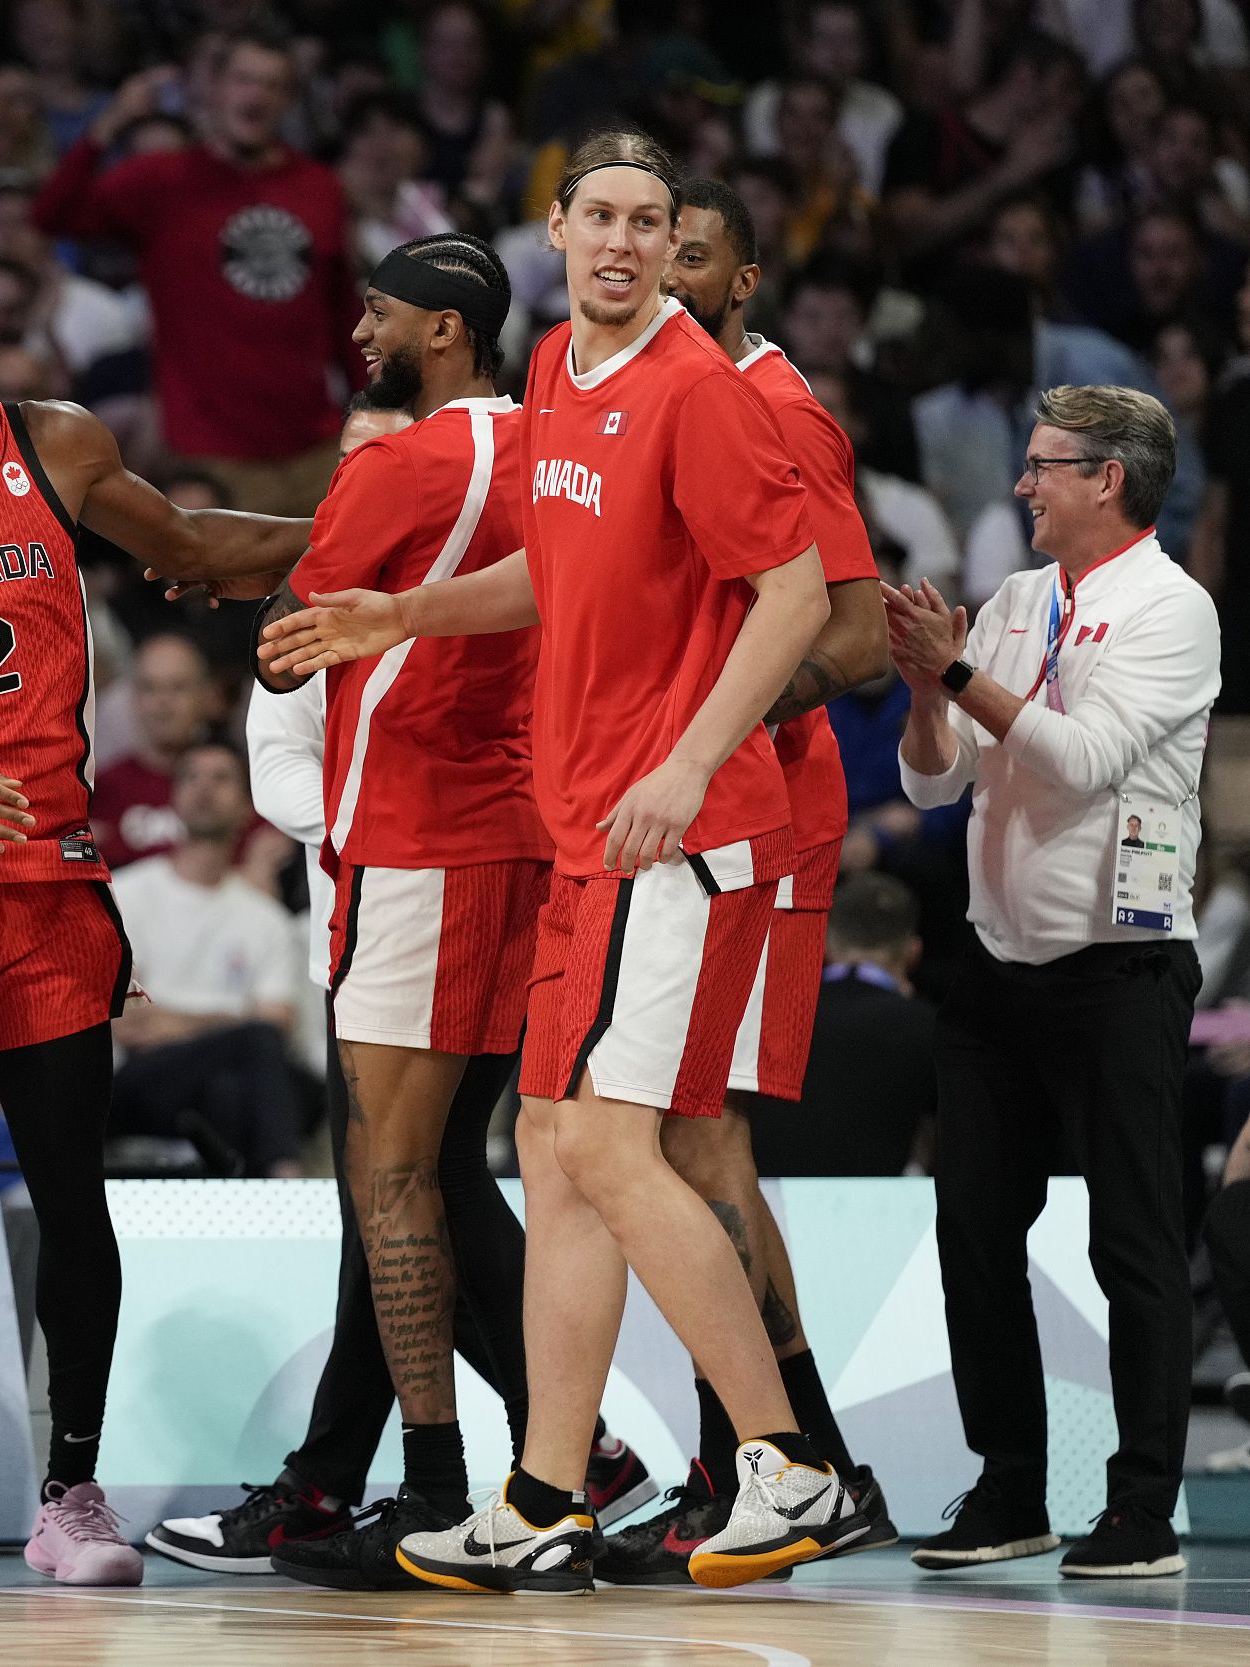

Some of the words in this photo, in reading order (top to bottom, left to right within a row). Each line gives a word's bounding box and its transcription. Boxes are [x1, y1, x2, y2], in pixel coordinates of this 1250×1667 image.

[1118, 910, 1126, 922] A
[1127, 911, 1135, 924] 2
[1163, 916, 1172, 929] R
